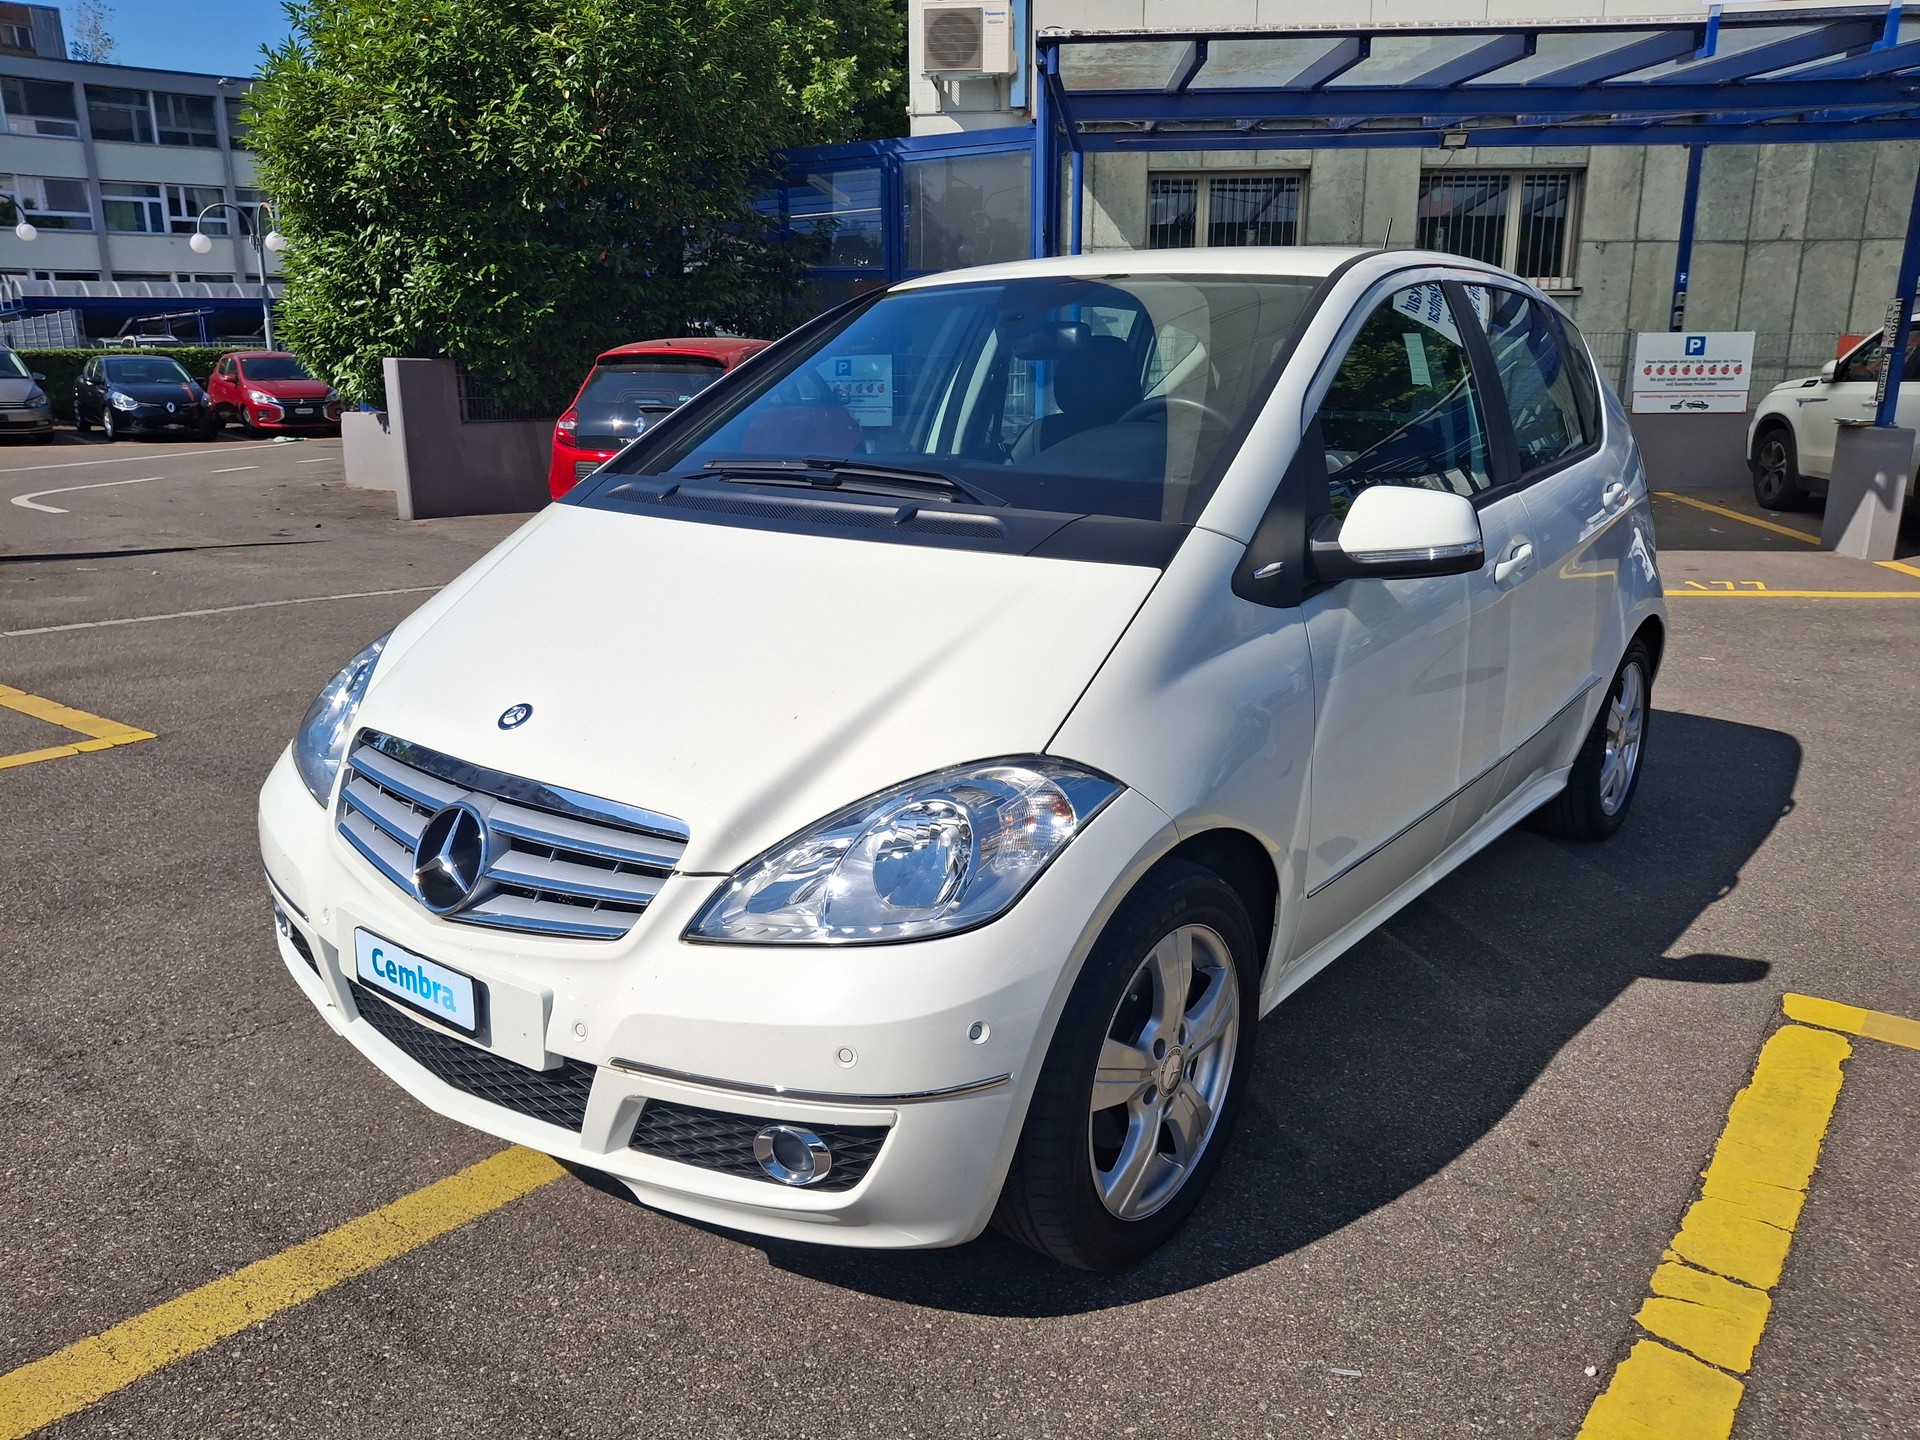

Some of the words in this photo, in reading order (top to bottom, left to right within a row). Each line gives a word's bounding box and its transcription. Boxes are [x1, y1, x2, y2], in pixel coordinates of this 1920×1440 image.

[1689, 338, 1701, 353] P
[839, 361, 848, 374] P
[372, 948, 456, 1012] Cembra
